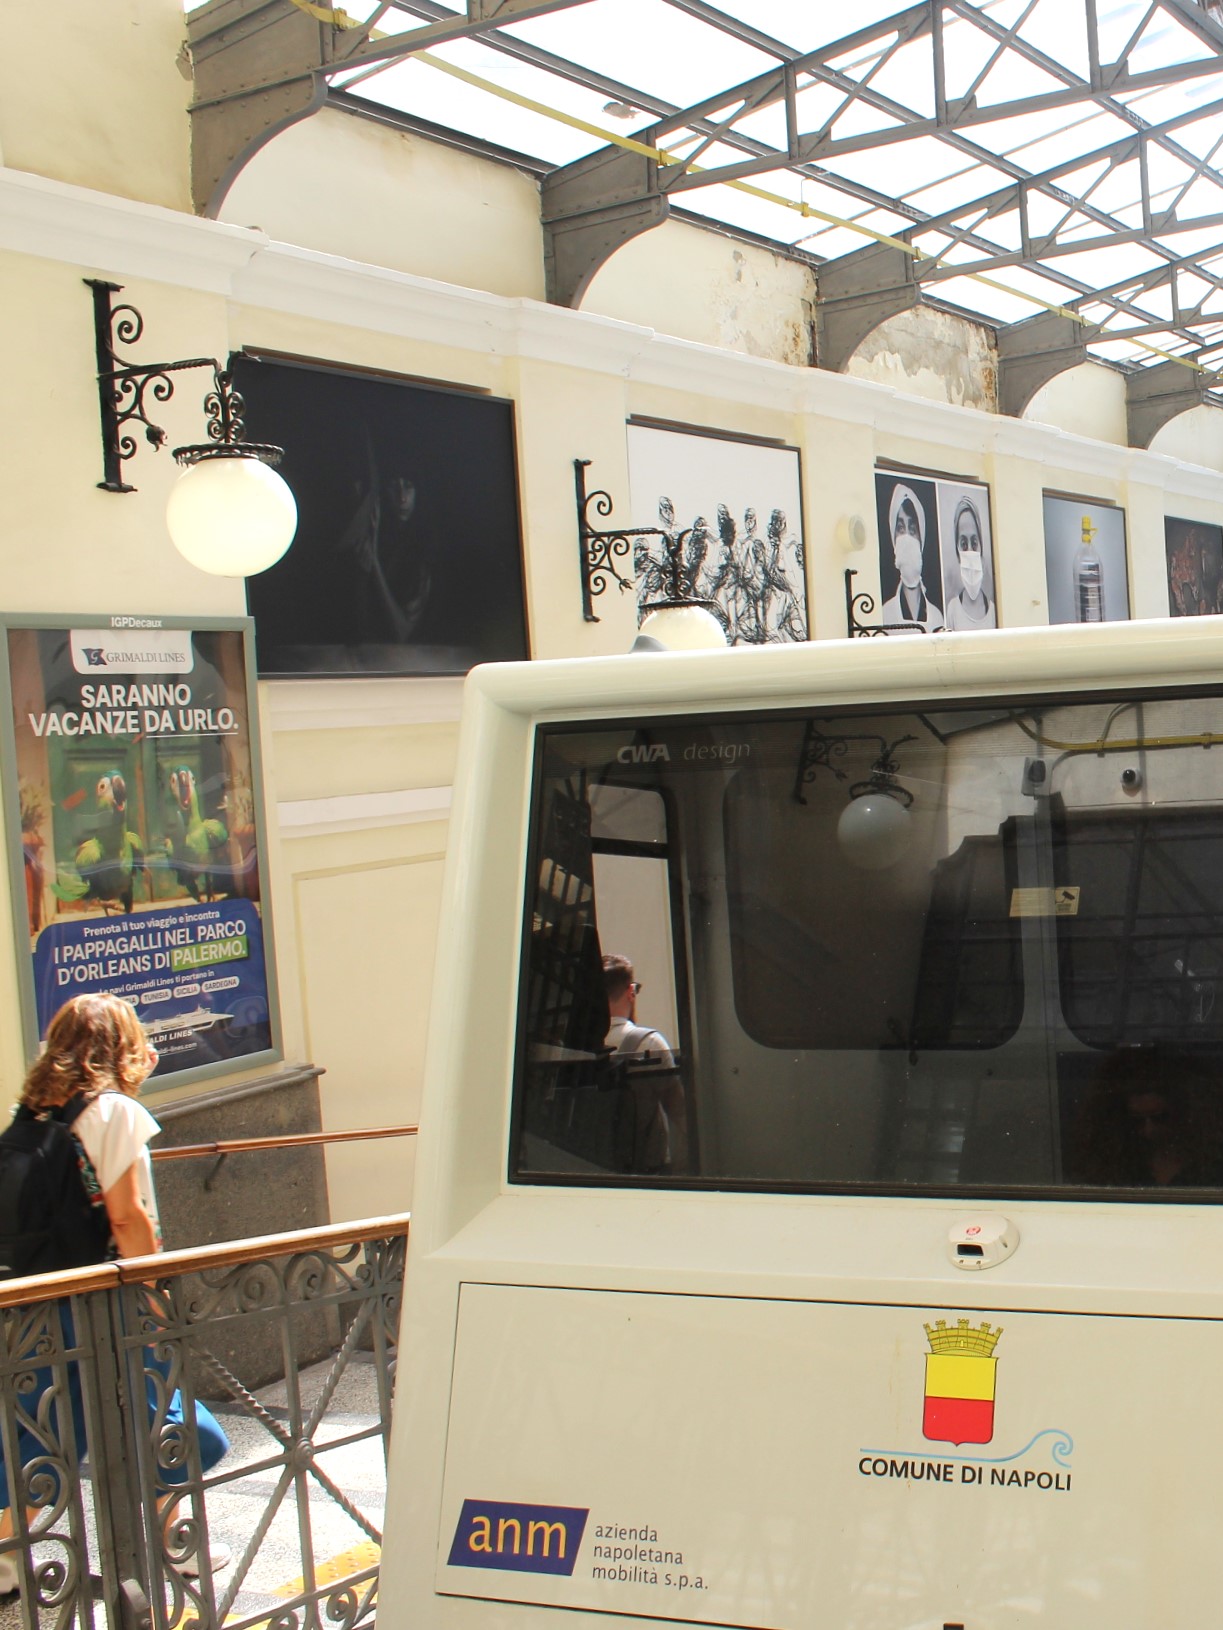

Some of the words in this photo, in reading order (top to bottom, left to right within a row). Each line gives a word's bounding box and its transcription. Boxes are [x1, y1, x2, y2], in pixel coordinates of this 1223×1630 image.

[111, 616, 163, 628] IGPDecaux
[106, 652, 158, 663] GRIMALDI
[159, 652, 186, 663] LINES
[81, 683, 191, 709] SARANNO
[28, 710, 141, 737] VACANZE
[144, 709, 176, 733] DA
[179, 707, 239, 731] URLO.
[617, 743, 671, 764] CWA
[683, 742, 750, 764] design
[84, 922, 122, 938] Prenota
[130, 920, 145, 930] tuo
[147, 915, 177, 929] viaggio
[185, 909, 220, 923] incontra
[54, 947, 59, 965] I
[63, 931, 163, 964] PAPPAGALLI
[165, 928, 194, 947] NEL
[197, 919, 247, 941] PARCO
[57, 955, 151, 986] D'ORLEANS
[155, 951, 170, 969] DI
[173, 940, 247, 967] PALERMO.
[125, 980, 156, 993] Grimaldi
[156, 977, 174, 986] Lines
[181, 972, 208, 984] portano
[203, 979, 238, 991] SARDEGNA
[169, 1030, 193, 1041] LINES
[858, 1456, 954, 1483] COMUNE
[960, 1464, 983, 1485] DI
[990, 1467, 1072, 1491] NAPOLI
[468, 1514, 567, 1560] anm
[594, 1523, 659, 1543] azienda
[593, 1544, 684, 1565] napoletana
[592, 1565, 659, 1586] mobilità
[664, 1573, 709, 1591] s.p.a.
